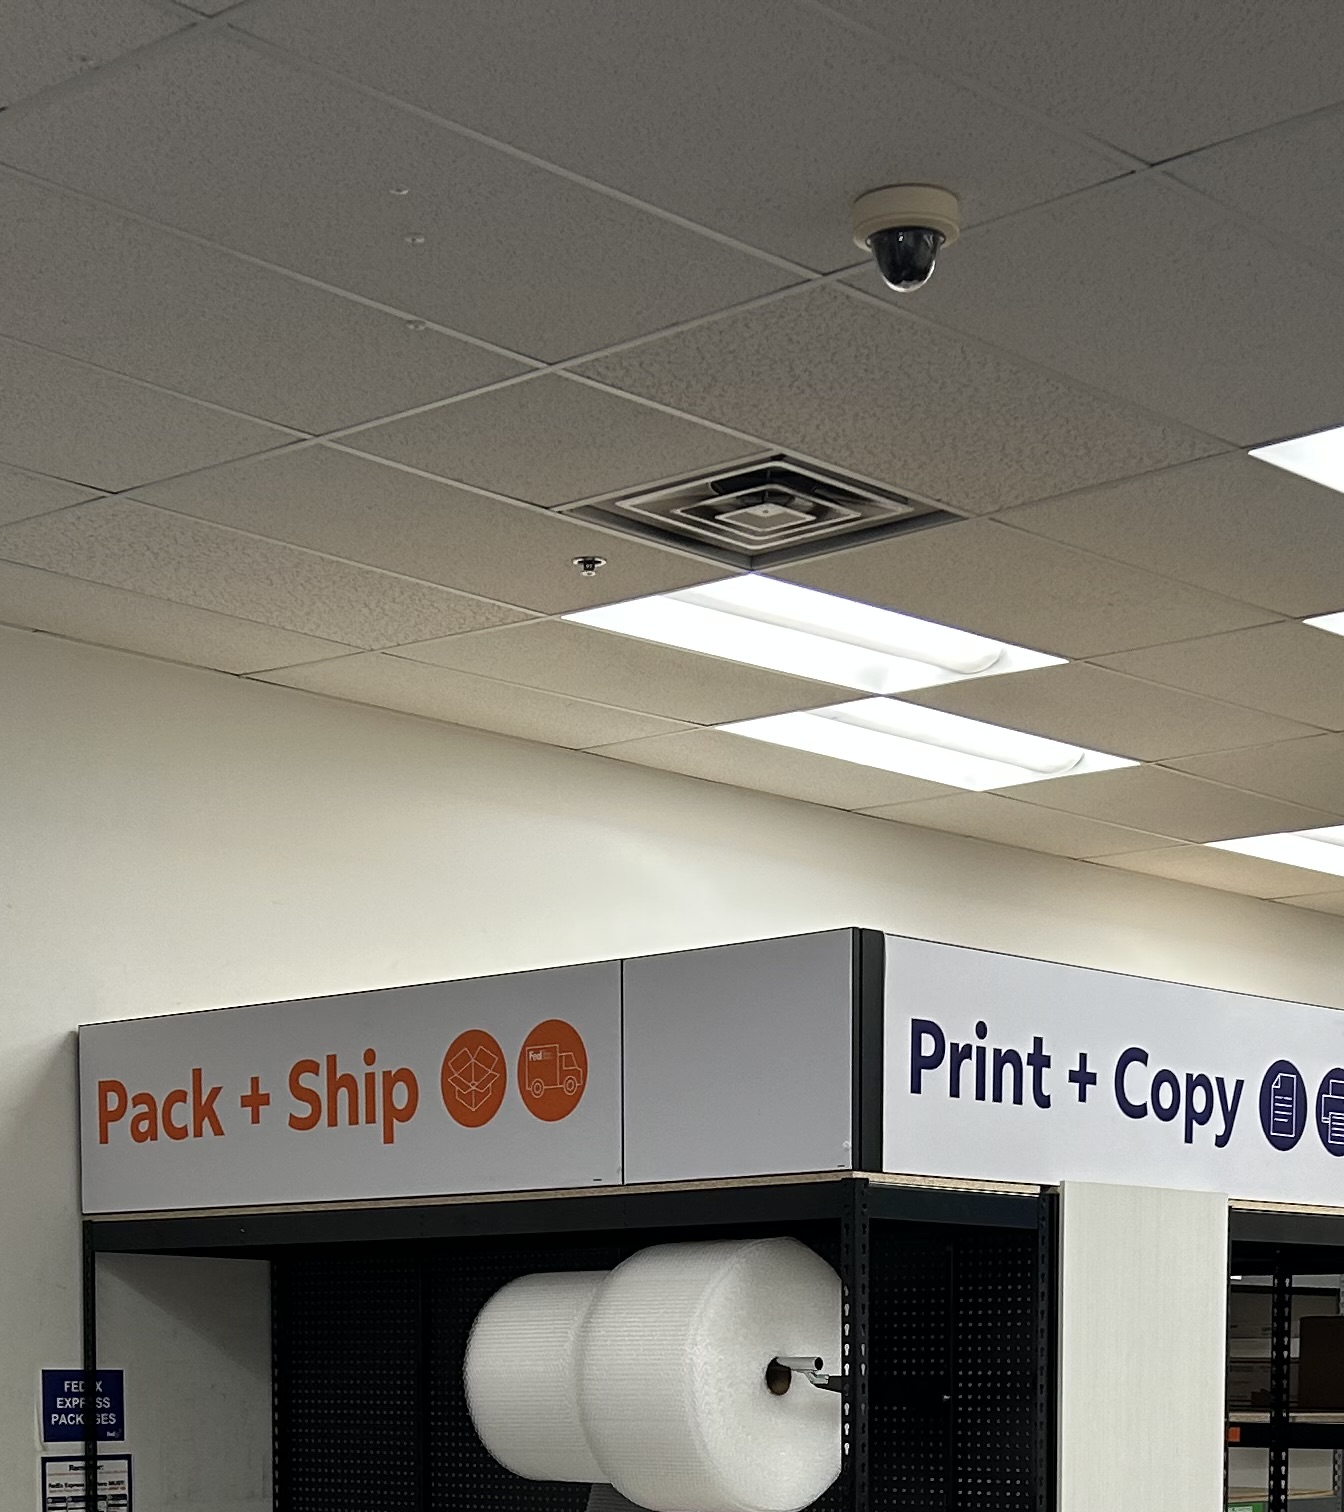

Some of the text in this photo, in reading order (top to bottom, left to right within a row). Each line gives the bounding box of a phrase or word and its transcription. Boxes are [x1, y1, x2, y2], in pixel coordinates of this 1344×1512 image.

[910, 1017, 1051, 1109] Print
[1114, 1047, 1244, 1148] Copy
[98, 1067, 225, 1145] Pack
[288, 1048, 419, 1145] Ship
[64, 1380, 102, 1392] FEDX
[56, 1397, 110, 1408] EXPRSS
[51, 1413, 116, 1425] PACKGES
